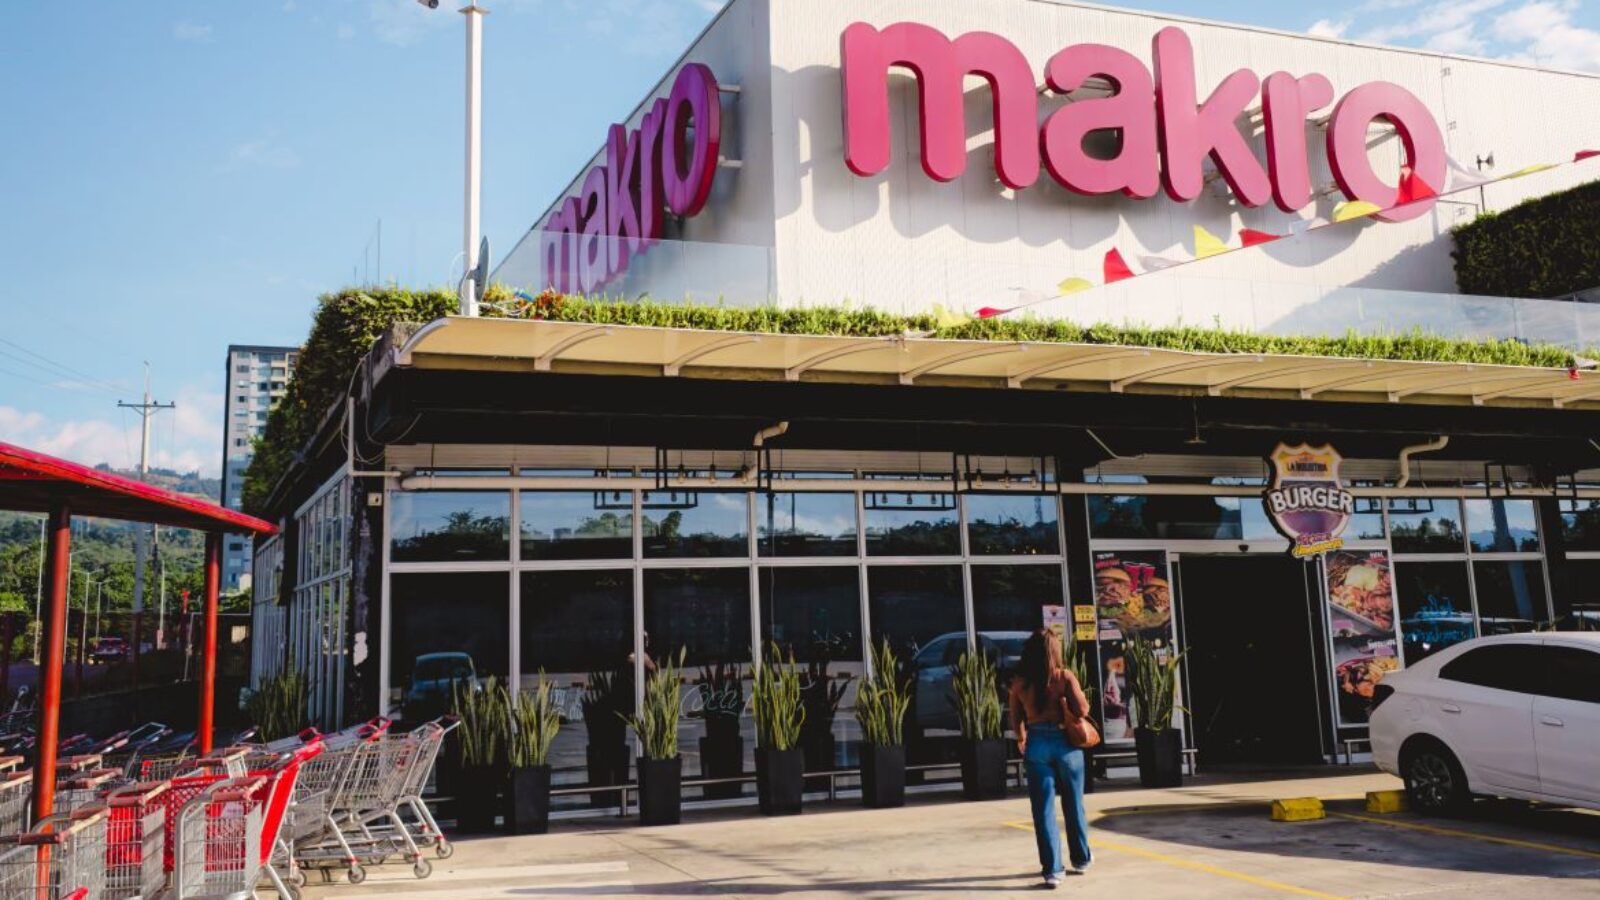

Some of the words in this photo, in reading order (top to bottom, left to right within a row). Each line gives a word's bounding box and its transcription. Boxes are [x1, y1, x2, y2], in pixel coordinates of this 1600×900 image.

[541, 63, 721, 297] makro
[840, 21, 1446, 222] makro
[1270, 487, 1353, 513] BURGER
